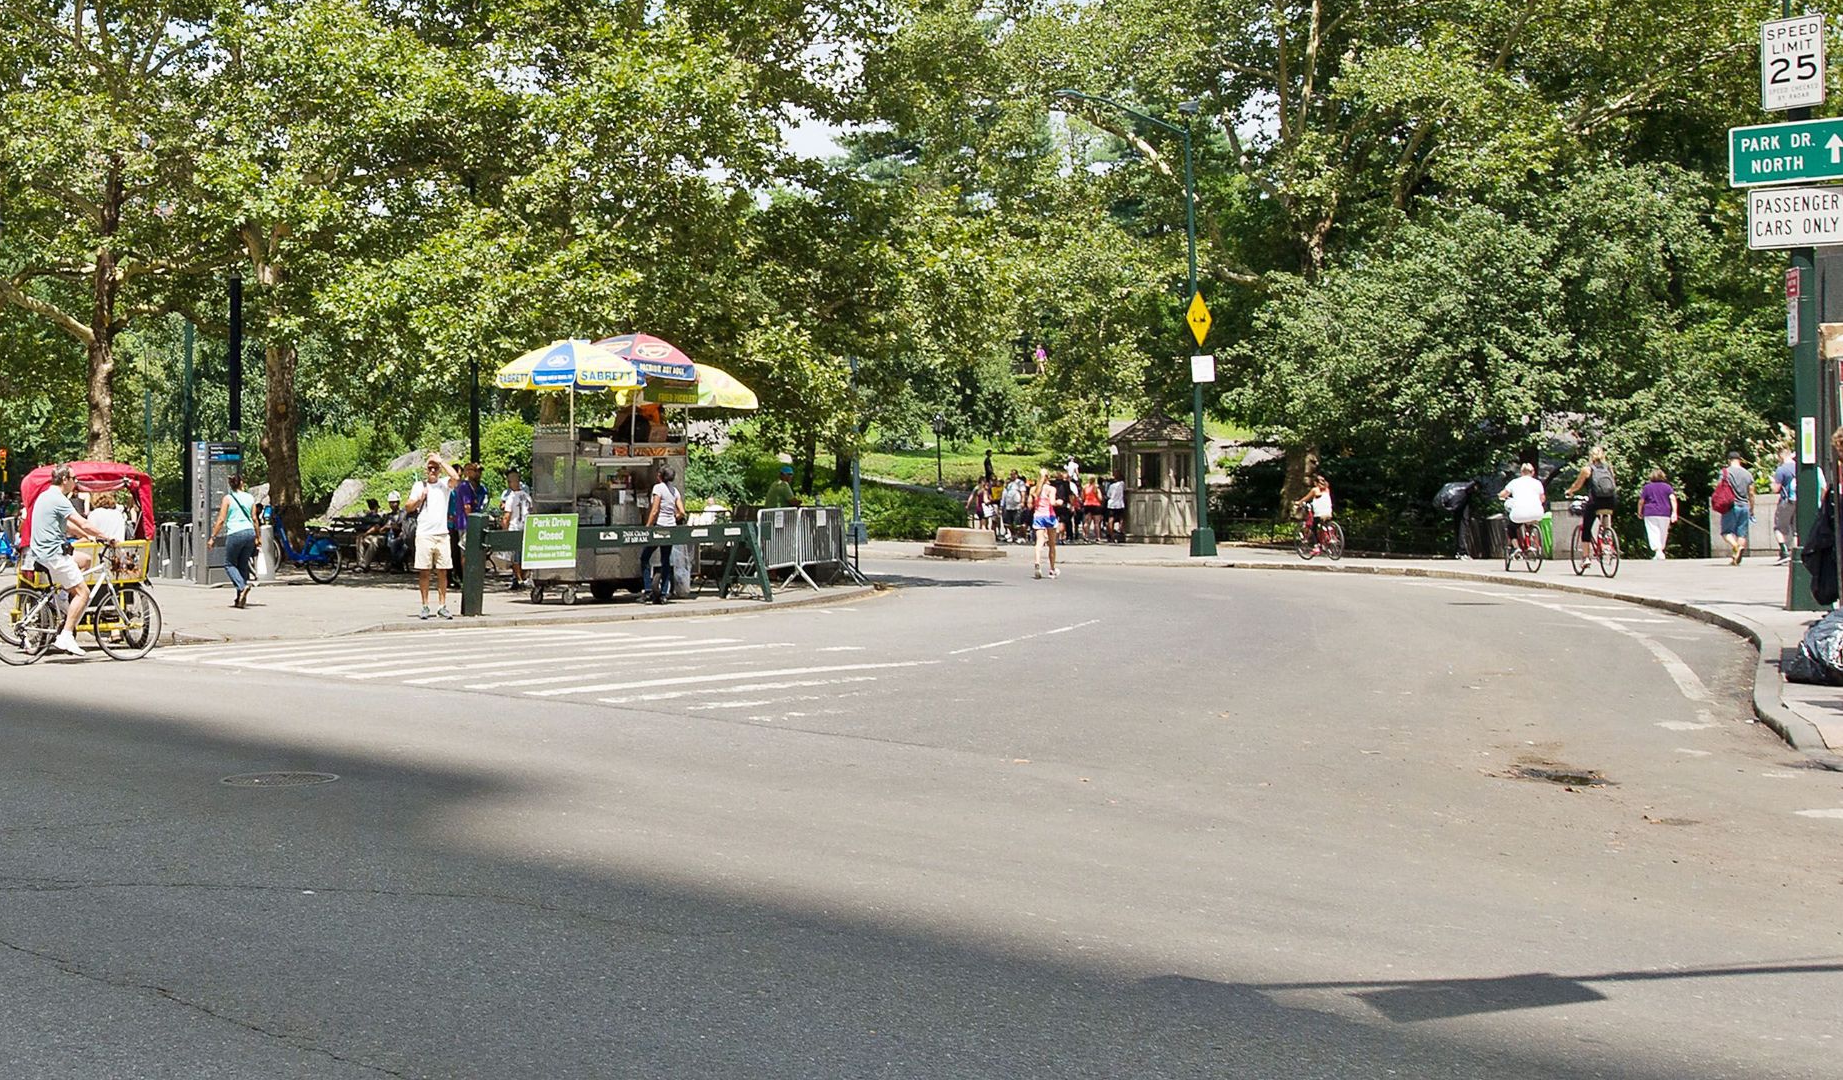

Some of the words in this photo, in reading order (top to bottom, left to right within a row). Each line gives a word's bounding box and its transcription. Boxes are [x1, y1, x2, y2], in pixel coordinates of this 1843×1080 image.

[1766, 23, 1818, 40] SPEED
[1772, 39, 1813, 55] LIMIT
[1770, 54, 1817, 84] 25
[1741, 135, 1781, 153] PARK
[1790, 132, 1816, 148] DR.
[1751, 155, 1804, 174] NORTH
[1756, 194, 1839, 215] PASSENGER
[1755, 219, 1793, 237] CARS
[1803, 216, 1839, 234] ONLY
[580, 370, 633, 382] SABRETT
[532, 517, 550, 528] Park
[551, 516, 572, 527] Drive
[538, 530, 564, 541] Closed
